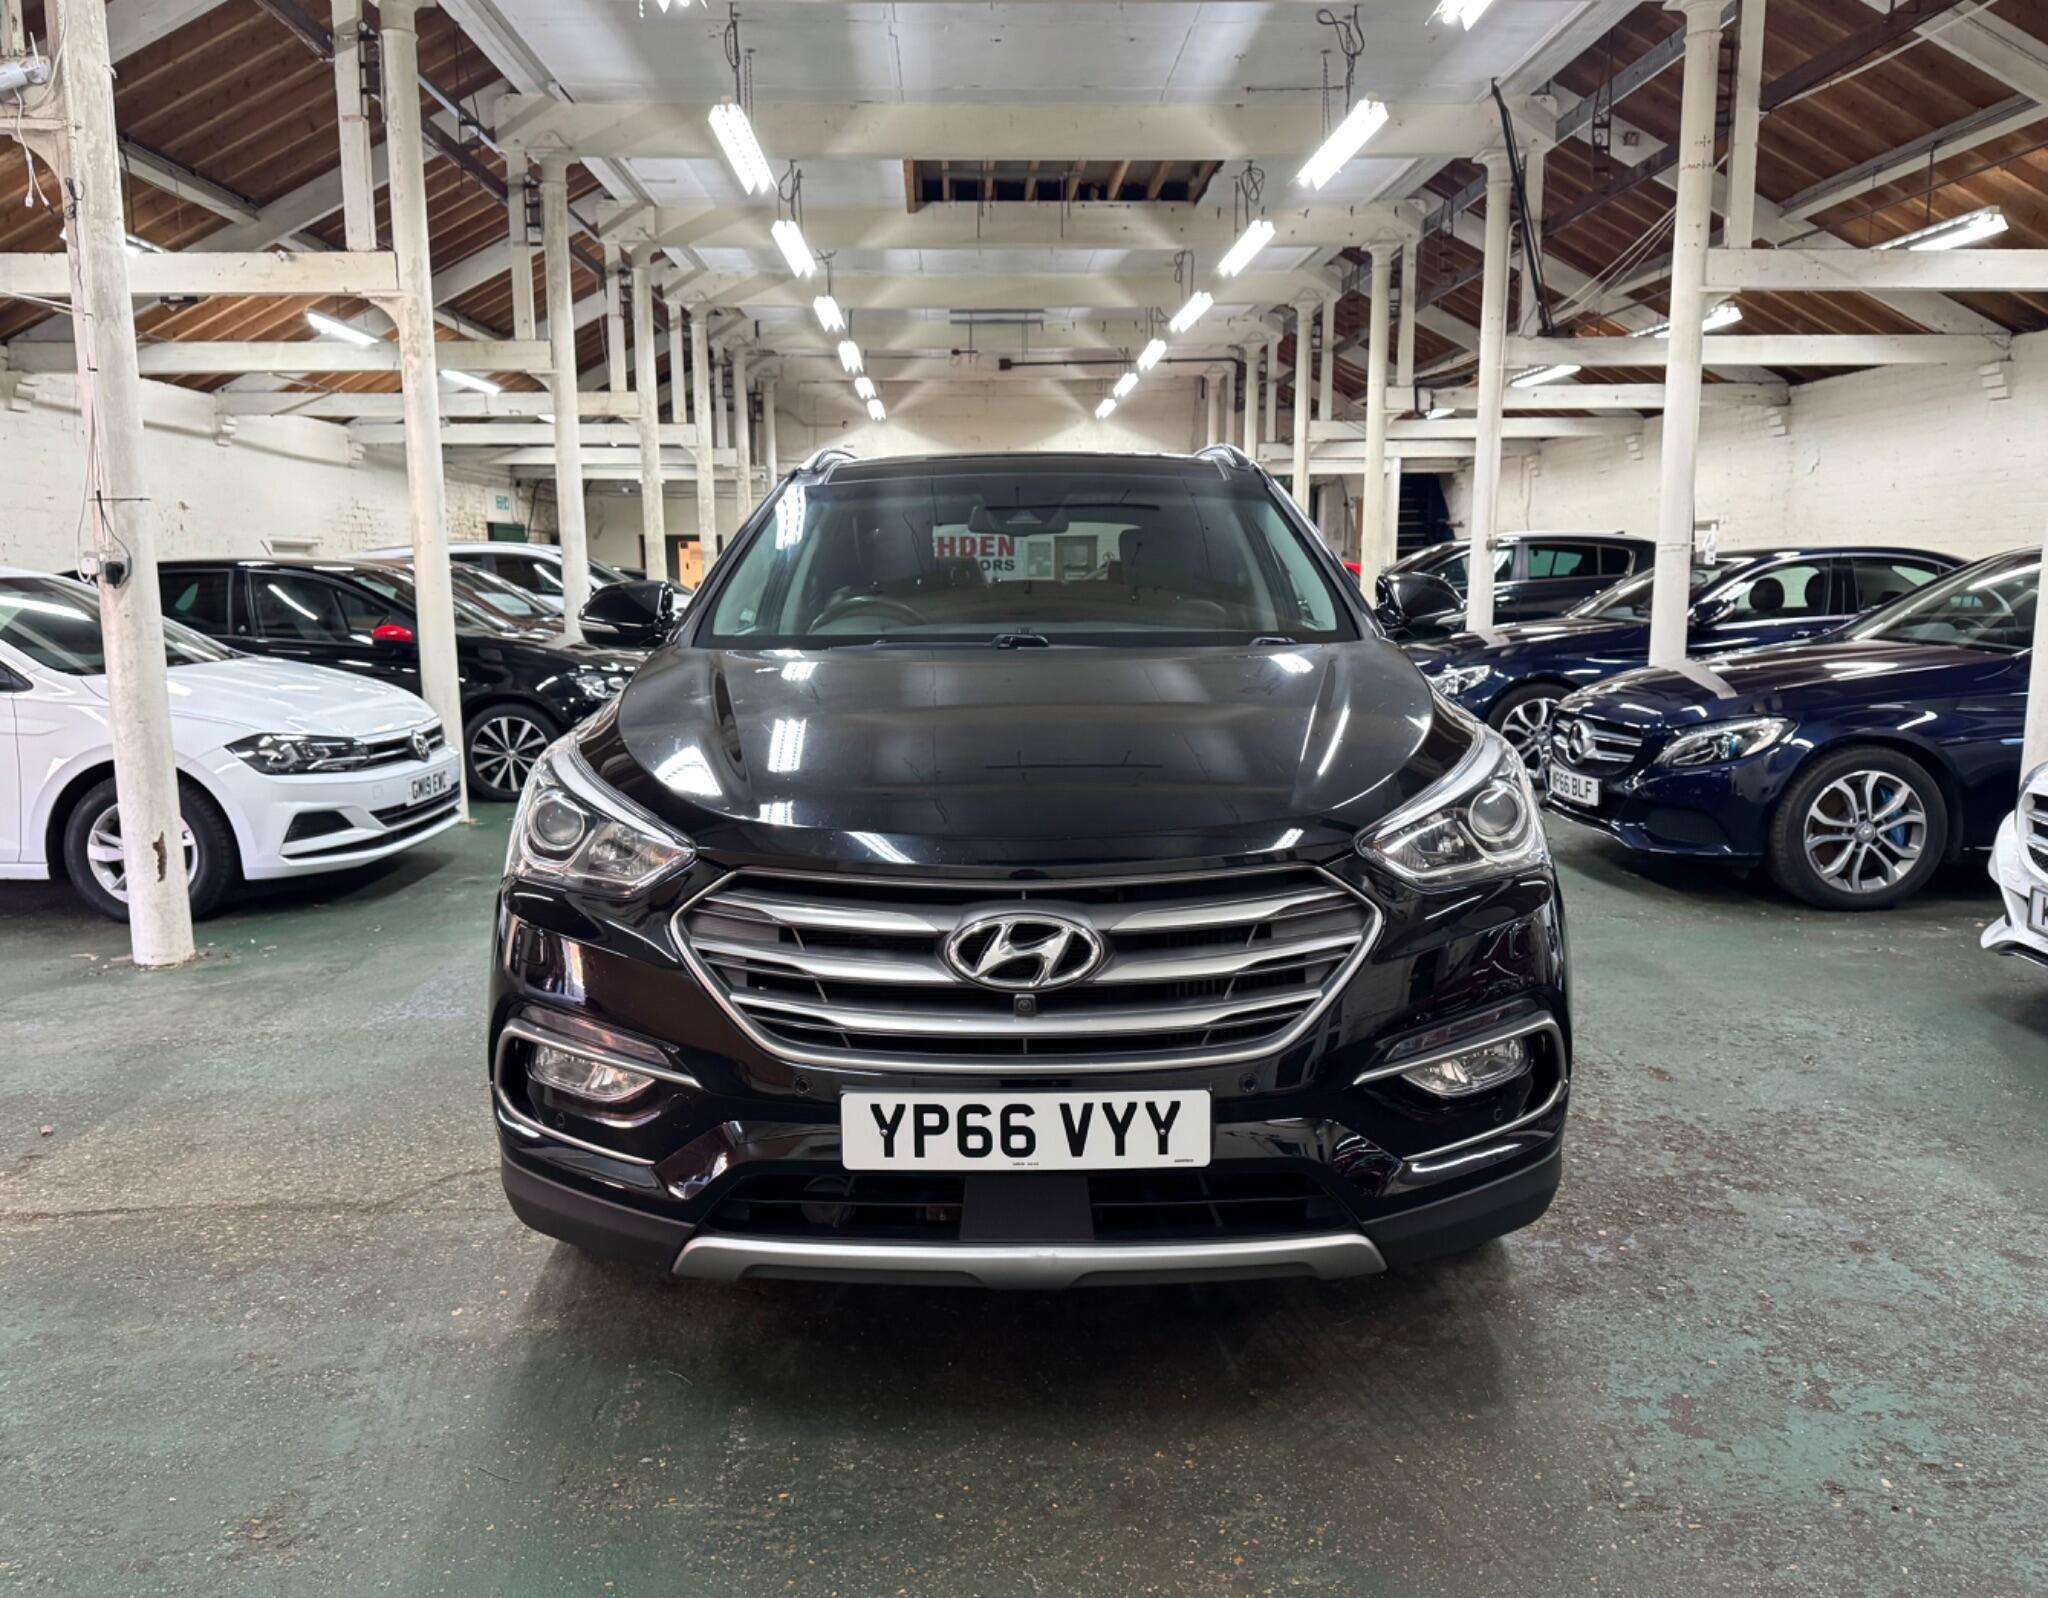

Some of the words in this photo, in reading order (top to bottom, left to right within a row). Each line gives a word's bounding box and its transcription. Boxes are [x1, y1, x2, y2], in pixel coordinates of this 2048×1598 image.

[1571, 776, 1593, 800] BLF
[870, 1103, 1036, 1158] YP66
[1059, 1100, 1181, 1157] VYY
